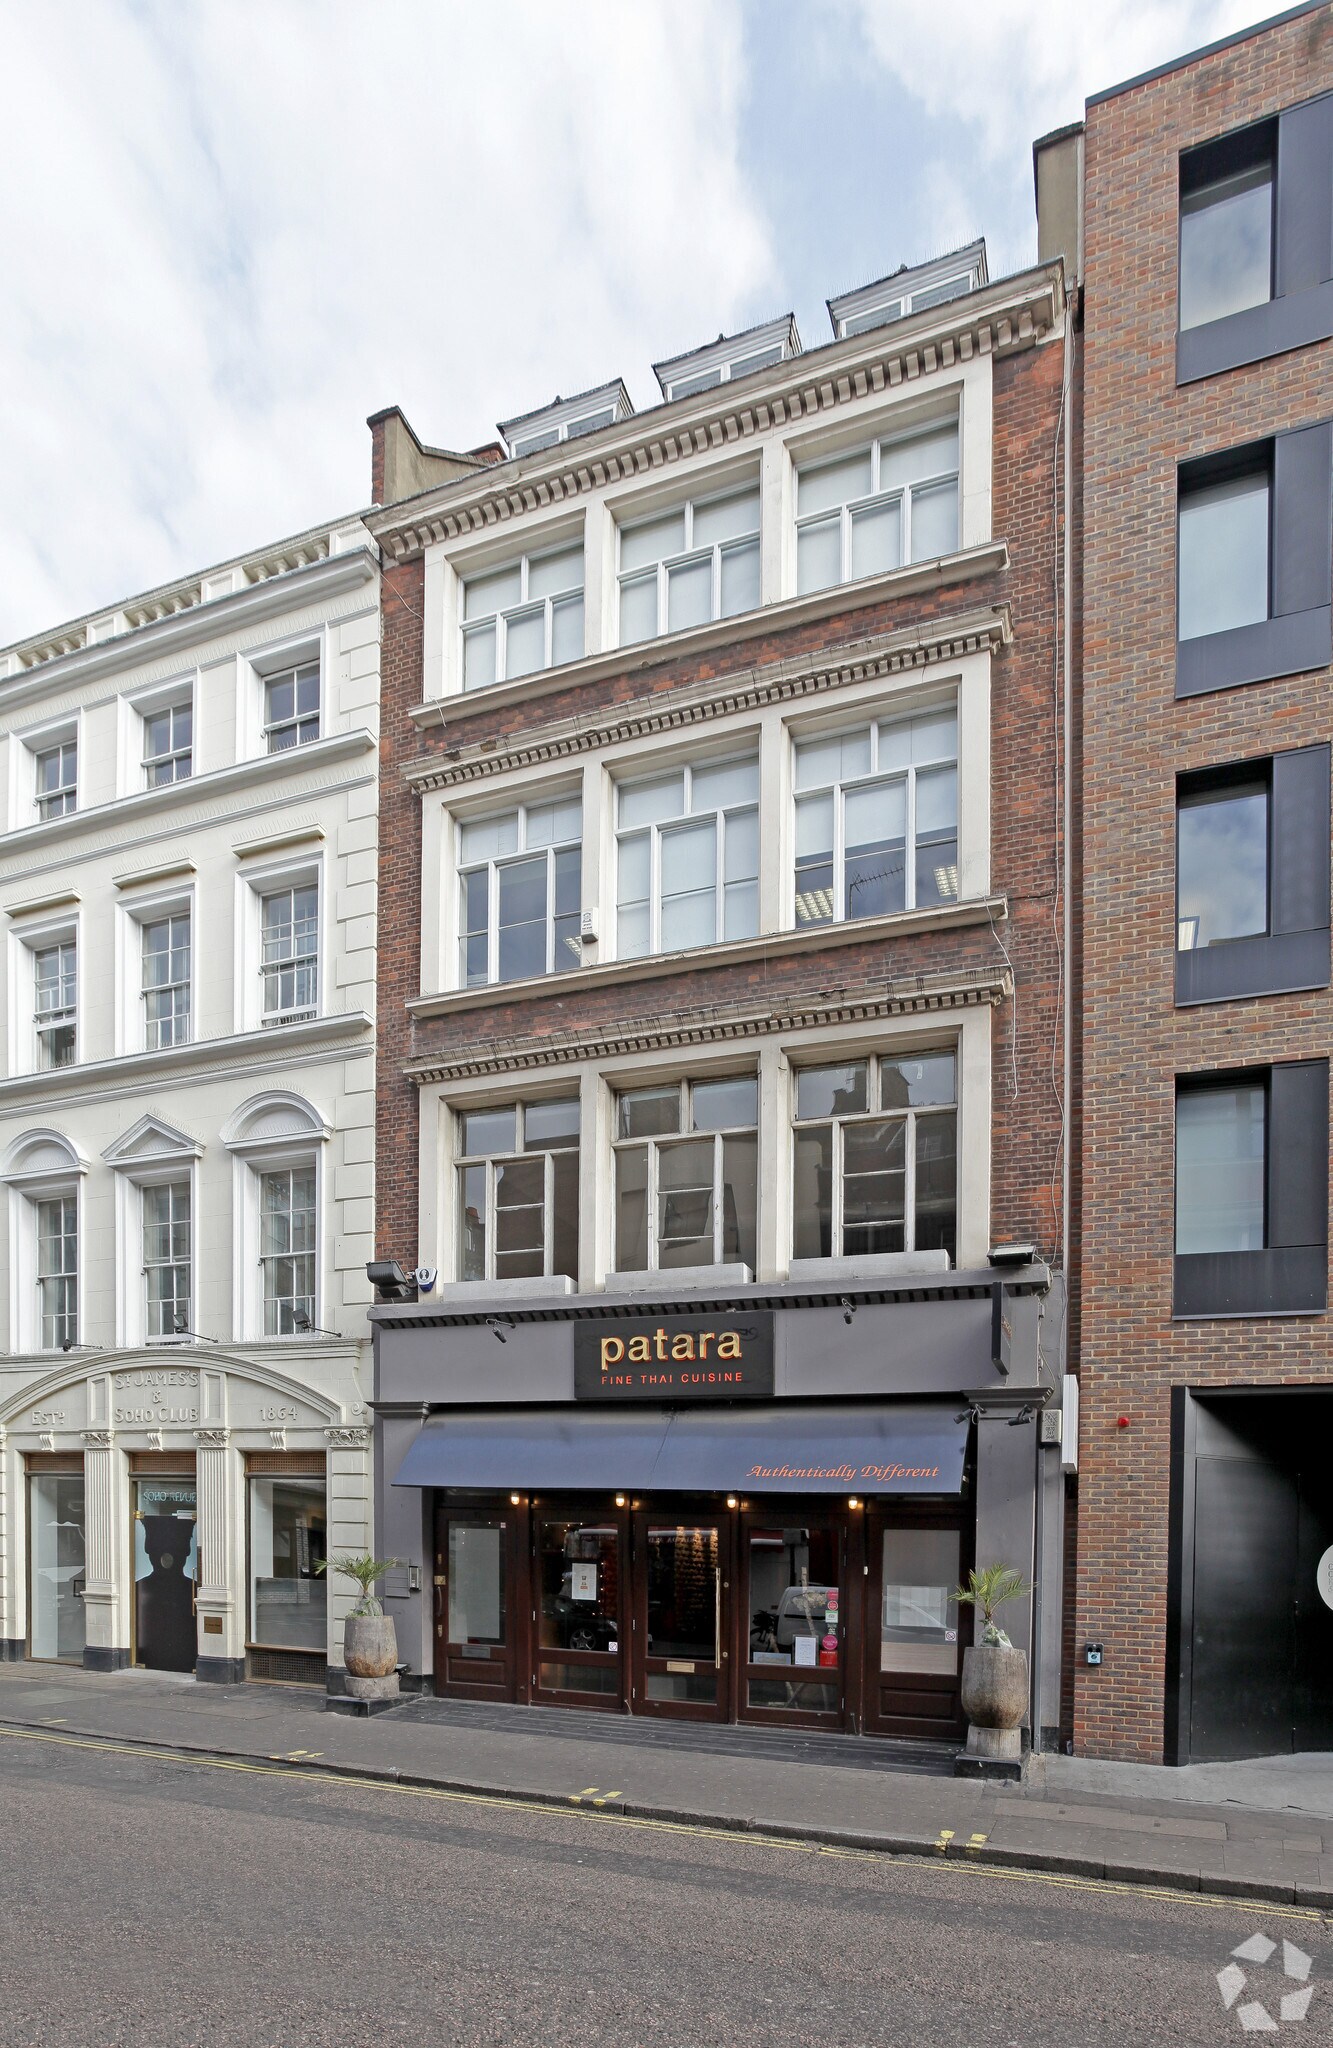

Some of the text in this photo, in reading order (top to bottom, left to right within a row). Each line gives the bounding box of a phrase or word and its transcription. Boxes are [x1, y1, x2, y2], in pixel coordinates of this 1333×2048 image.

[601, 1328, 743, 1372] patara
[134, 1370, 198, 1387] JAMES'S
[601, 1372, 743, 1385] FINE THAI CUISINE
[152, 1390, 162, 1404] &
[115, 1406, 198, 1423] SOHO CLUB
[260, 1405, 298, 1421] 1864
[746, 1464, 940, 1481] Authentically Different
[143, 1491, 167, 1502] SOHO
